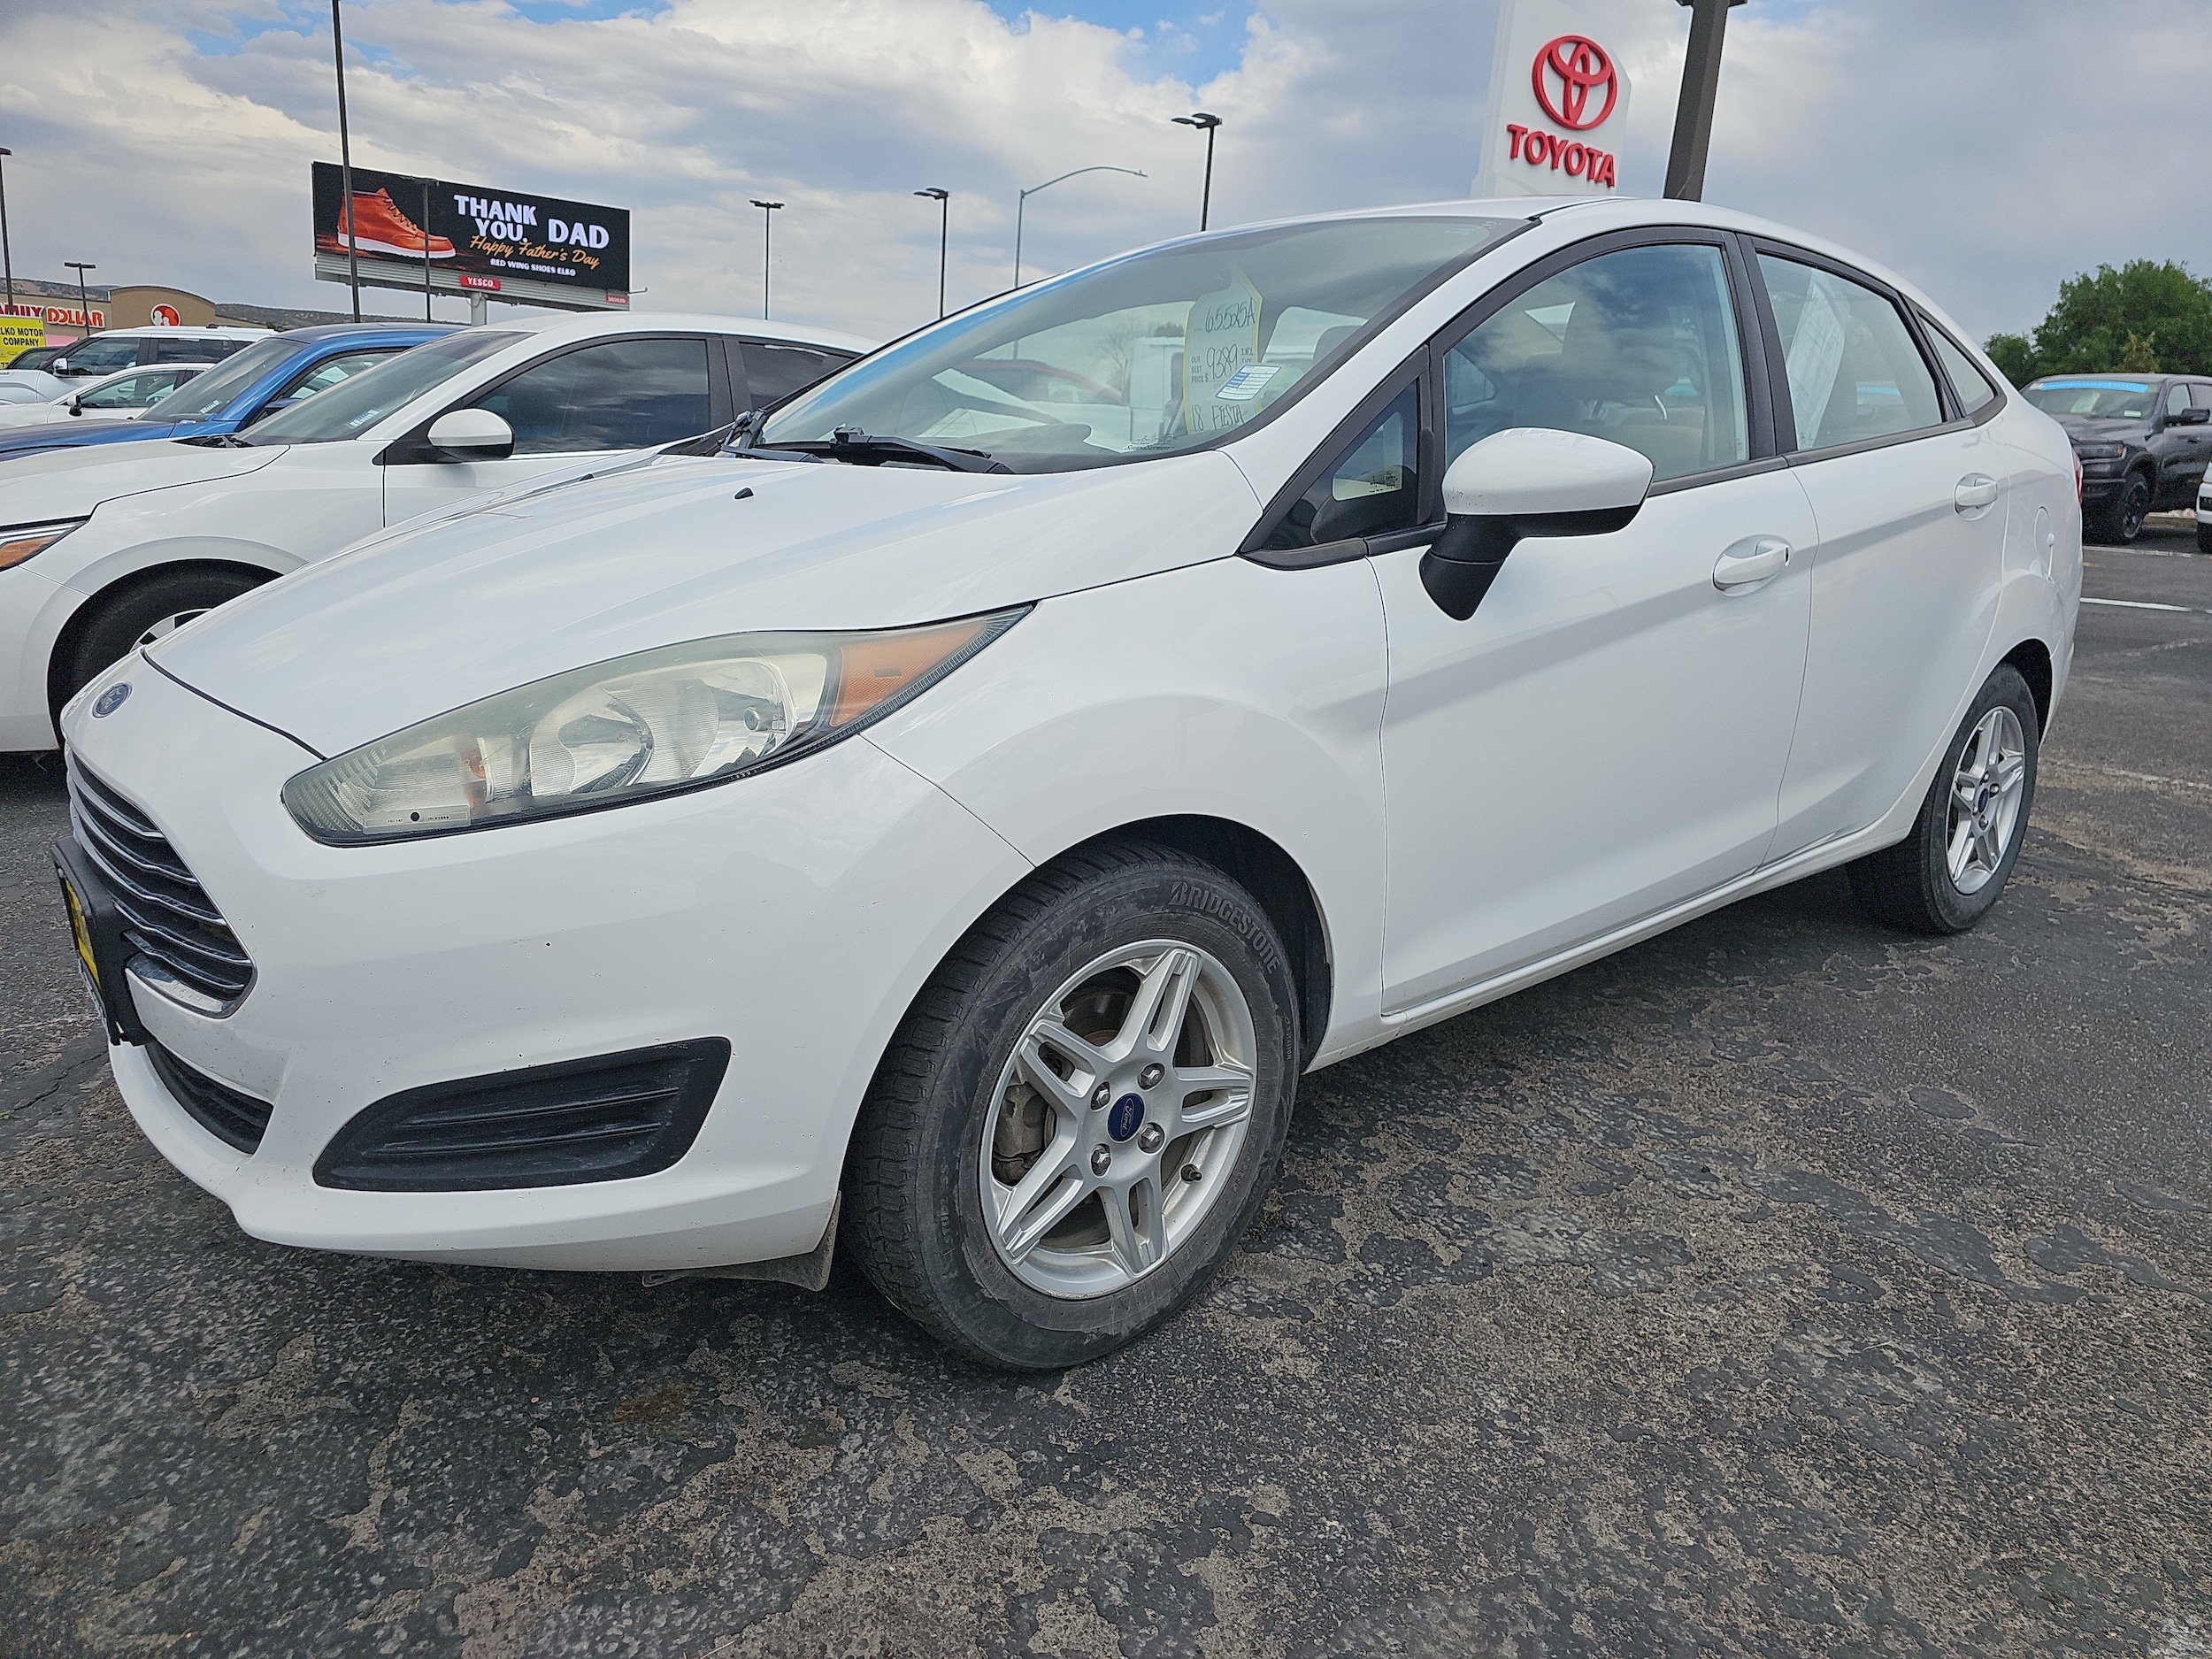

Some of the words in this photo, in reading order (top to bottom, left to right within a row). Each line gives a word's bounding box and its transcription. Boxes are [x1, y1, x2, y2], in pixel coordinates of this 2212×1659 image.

[1507, 124, 1615, 188] TOYOTA
[454, 194, 538, 227] THANK
[548, 219, 610, 249] DAD
[470, 235, 514, 258] Happy
[518, 241, 568, 263] Father's
[572, 249, 600, 270] Day
[490, 257, 506, 267] RED
[507, 260, 530, 271] WING
[531, 265, 556, 275] SHOES
[557, 267, 576, 277] ELKO
[47, 307, 104, 326] DOLLAR
[0, 327, 15, 336] LKO
[18, 327, 43, 337] MOTOR
[4, 337, 39, 347] COMPANY
[1206, 344, 1238, 380] 9389
[1191, 404, 1204, 432] 18
[1212, 403, 1246, 430] FIESTA
[1168, 880, 1281, 975] BRIDGESTONE
[1122, 1105, 1133, 1131] Ford
